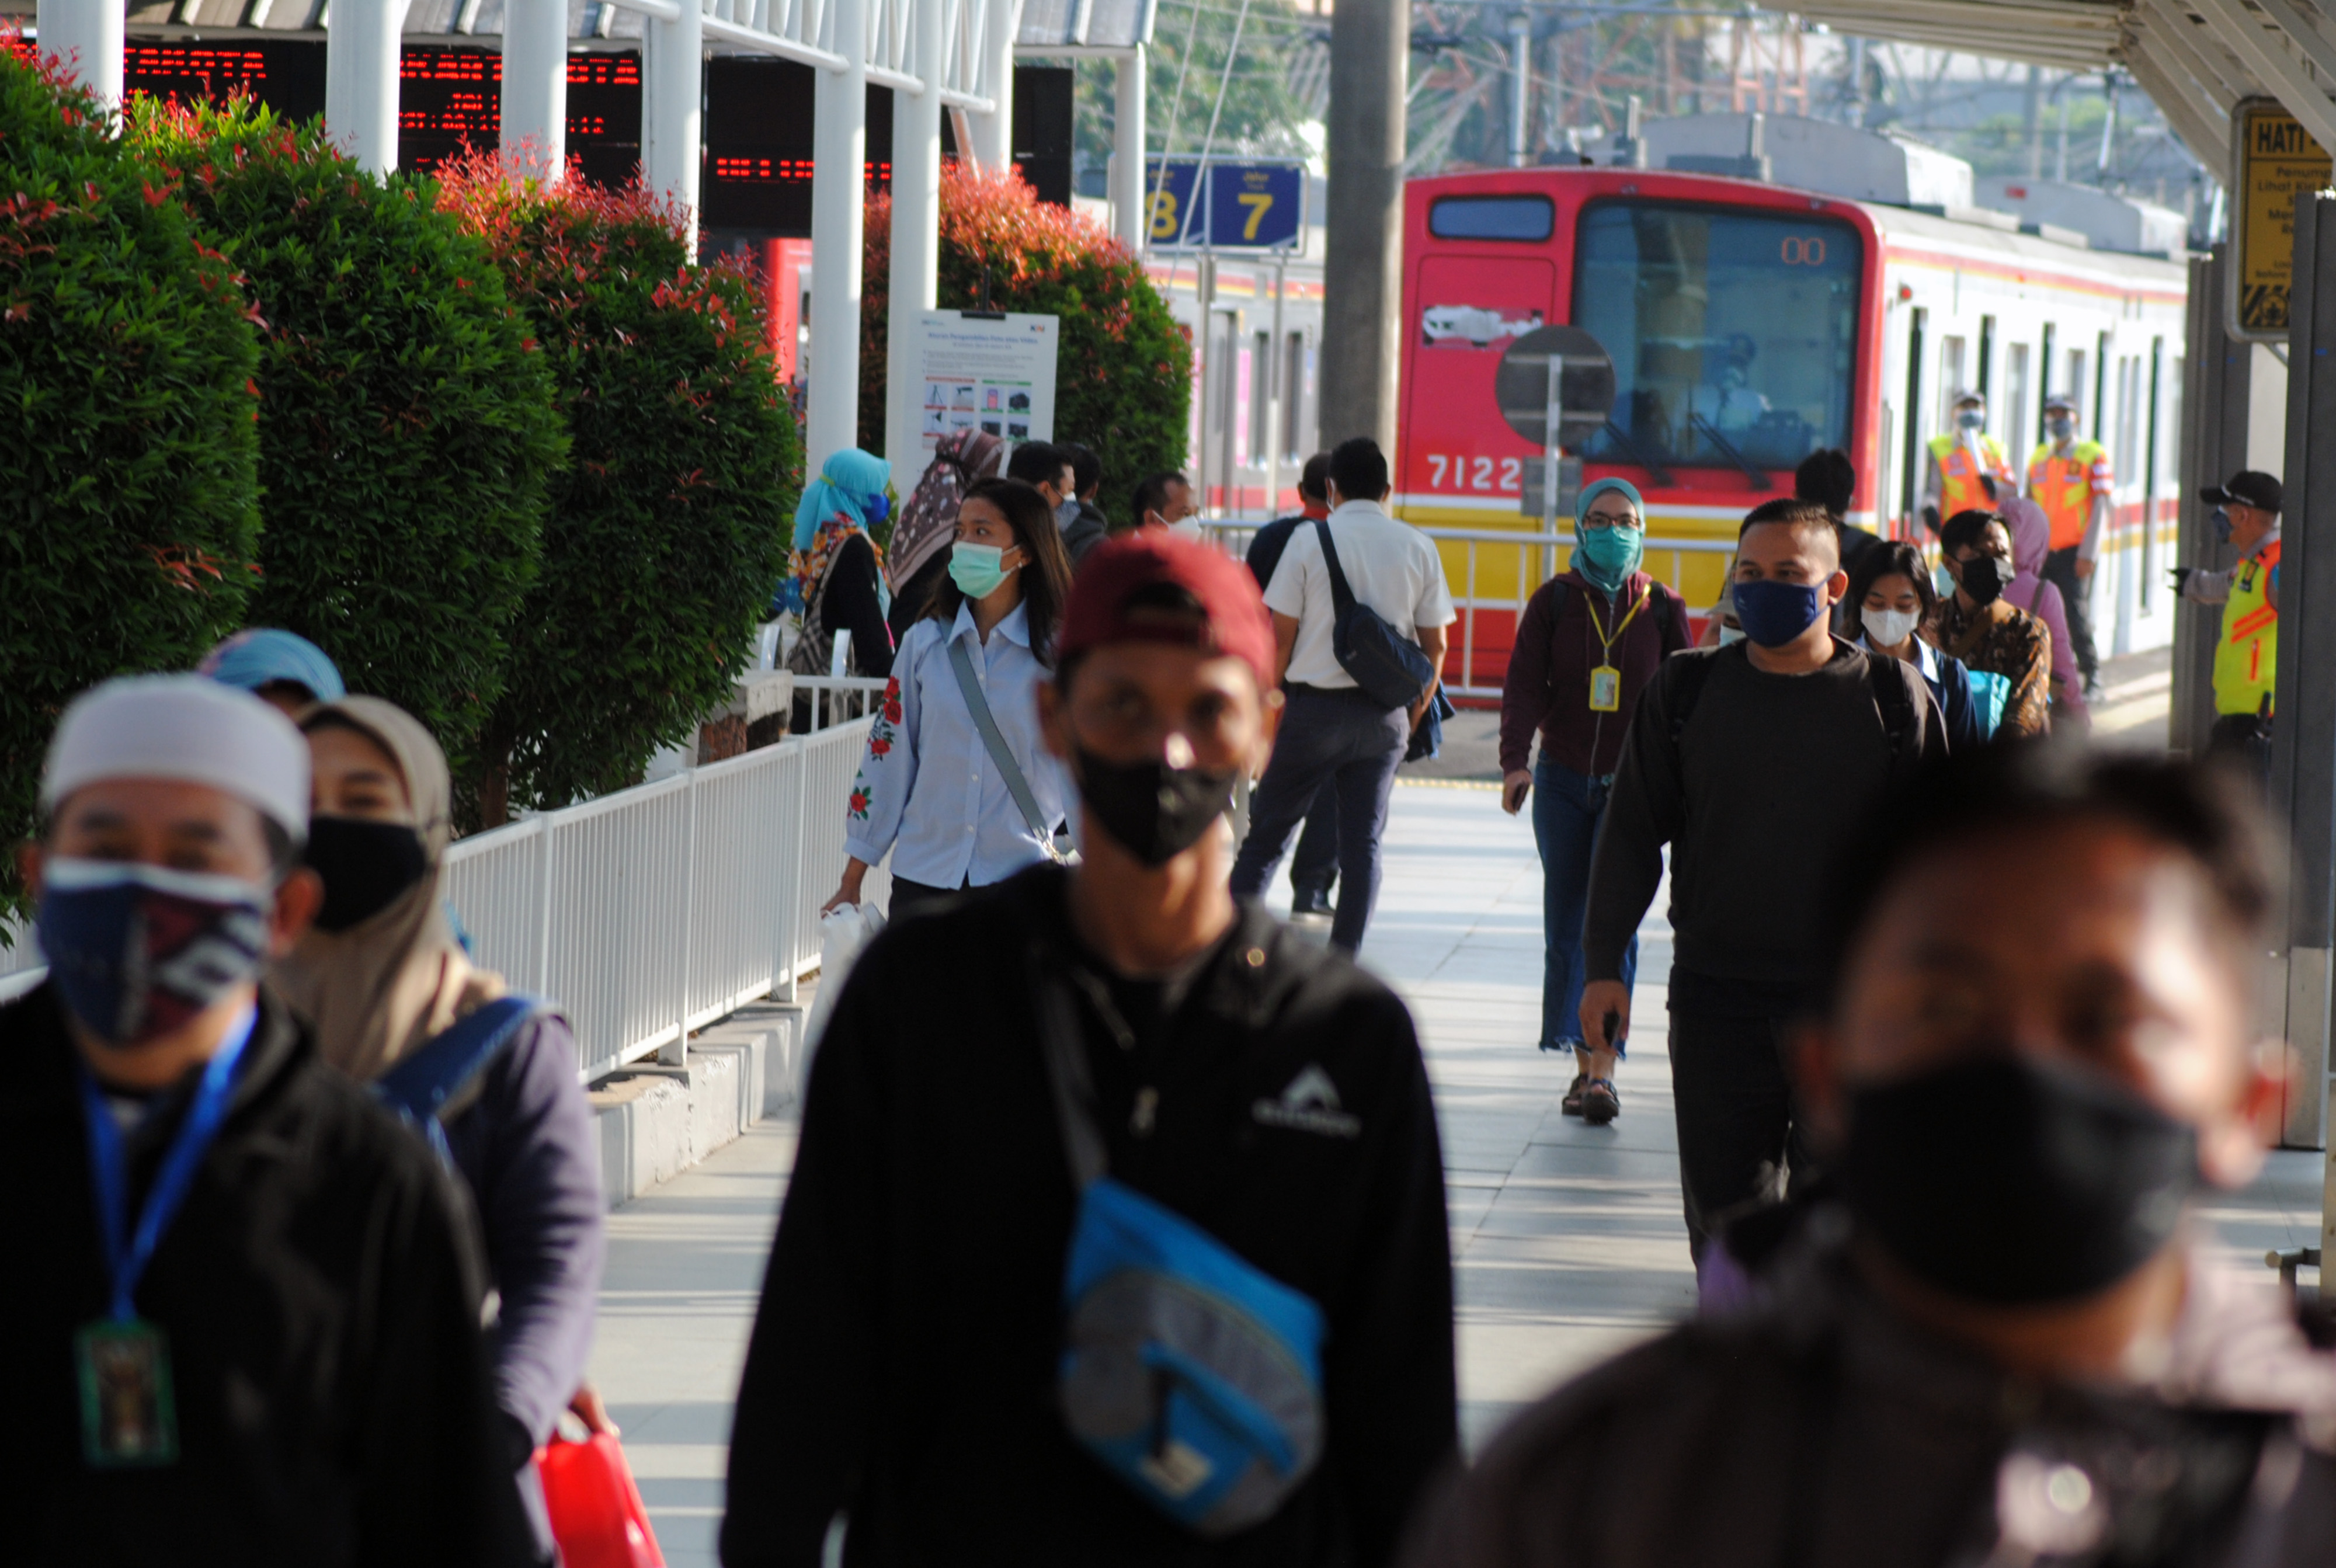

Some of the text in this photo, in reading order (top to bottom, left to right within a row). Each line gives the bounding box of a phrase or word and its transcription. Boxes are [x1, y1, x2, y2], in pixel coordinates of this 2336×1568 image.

[2258, 123, 2304, 153] HATI
[2277, 166, 2332, 179] Penump
[1145, 189, 1177, 238] 8
[1238, 193, 1273, 240] 7
[1427, 454, 1520, 490] 7122
